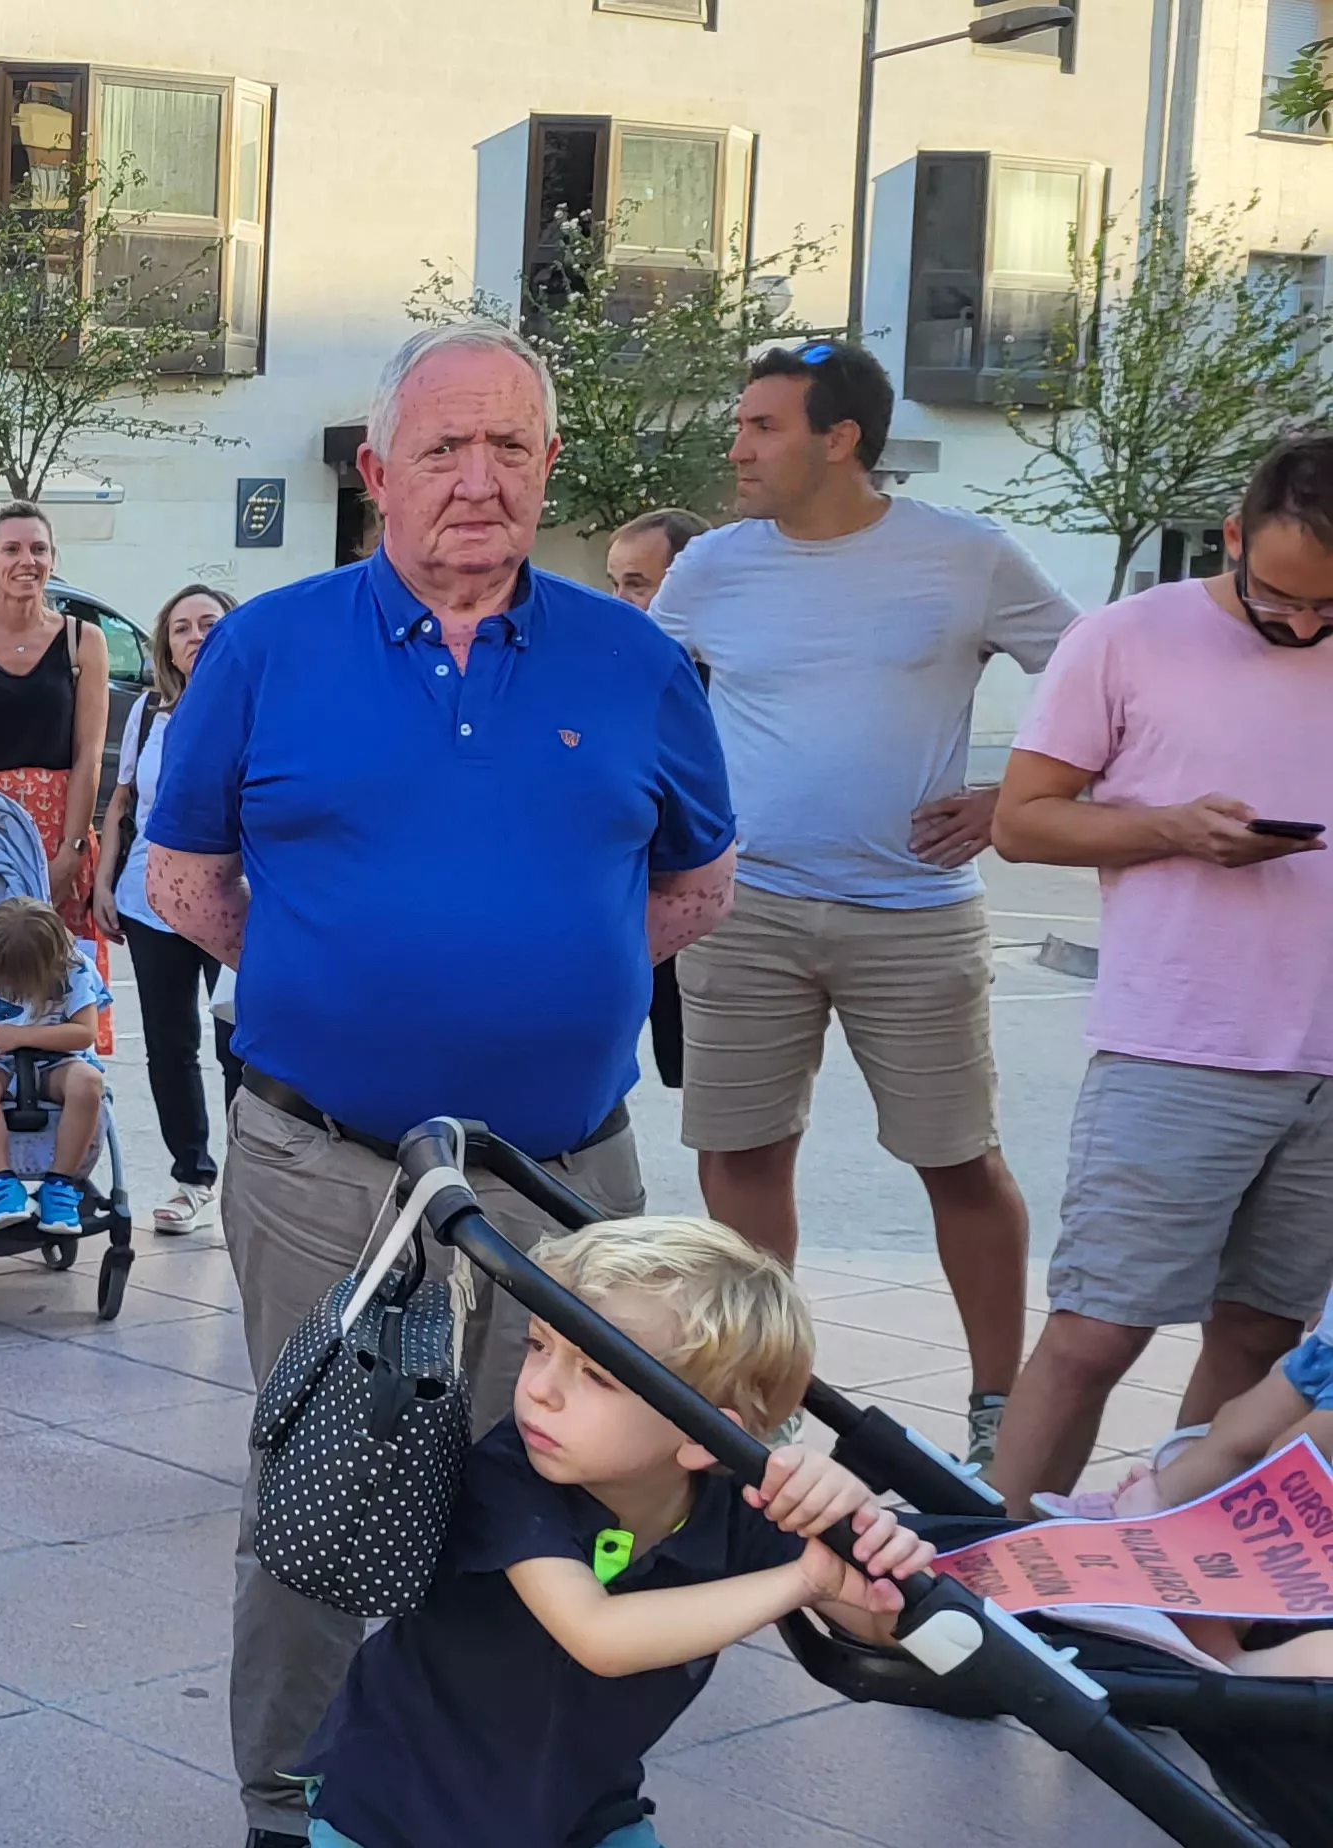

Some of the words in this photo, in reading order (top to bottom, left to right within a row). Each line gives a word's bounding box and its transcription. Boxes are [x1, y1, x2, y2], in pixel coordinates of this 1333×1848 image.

[1280, 1470, 1333, 1538] CURSO
[1075, 1553, 1119, 1569] DE
[1116, 1527, 1202, 1605] AUXILIARES
[1193, 1552, 1244, 1579] SIN
